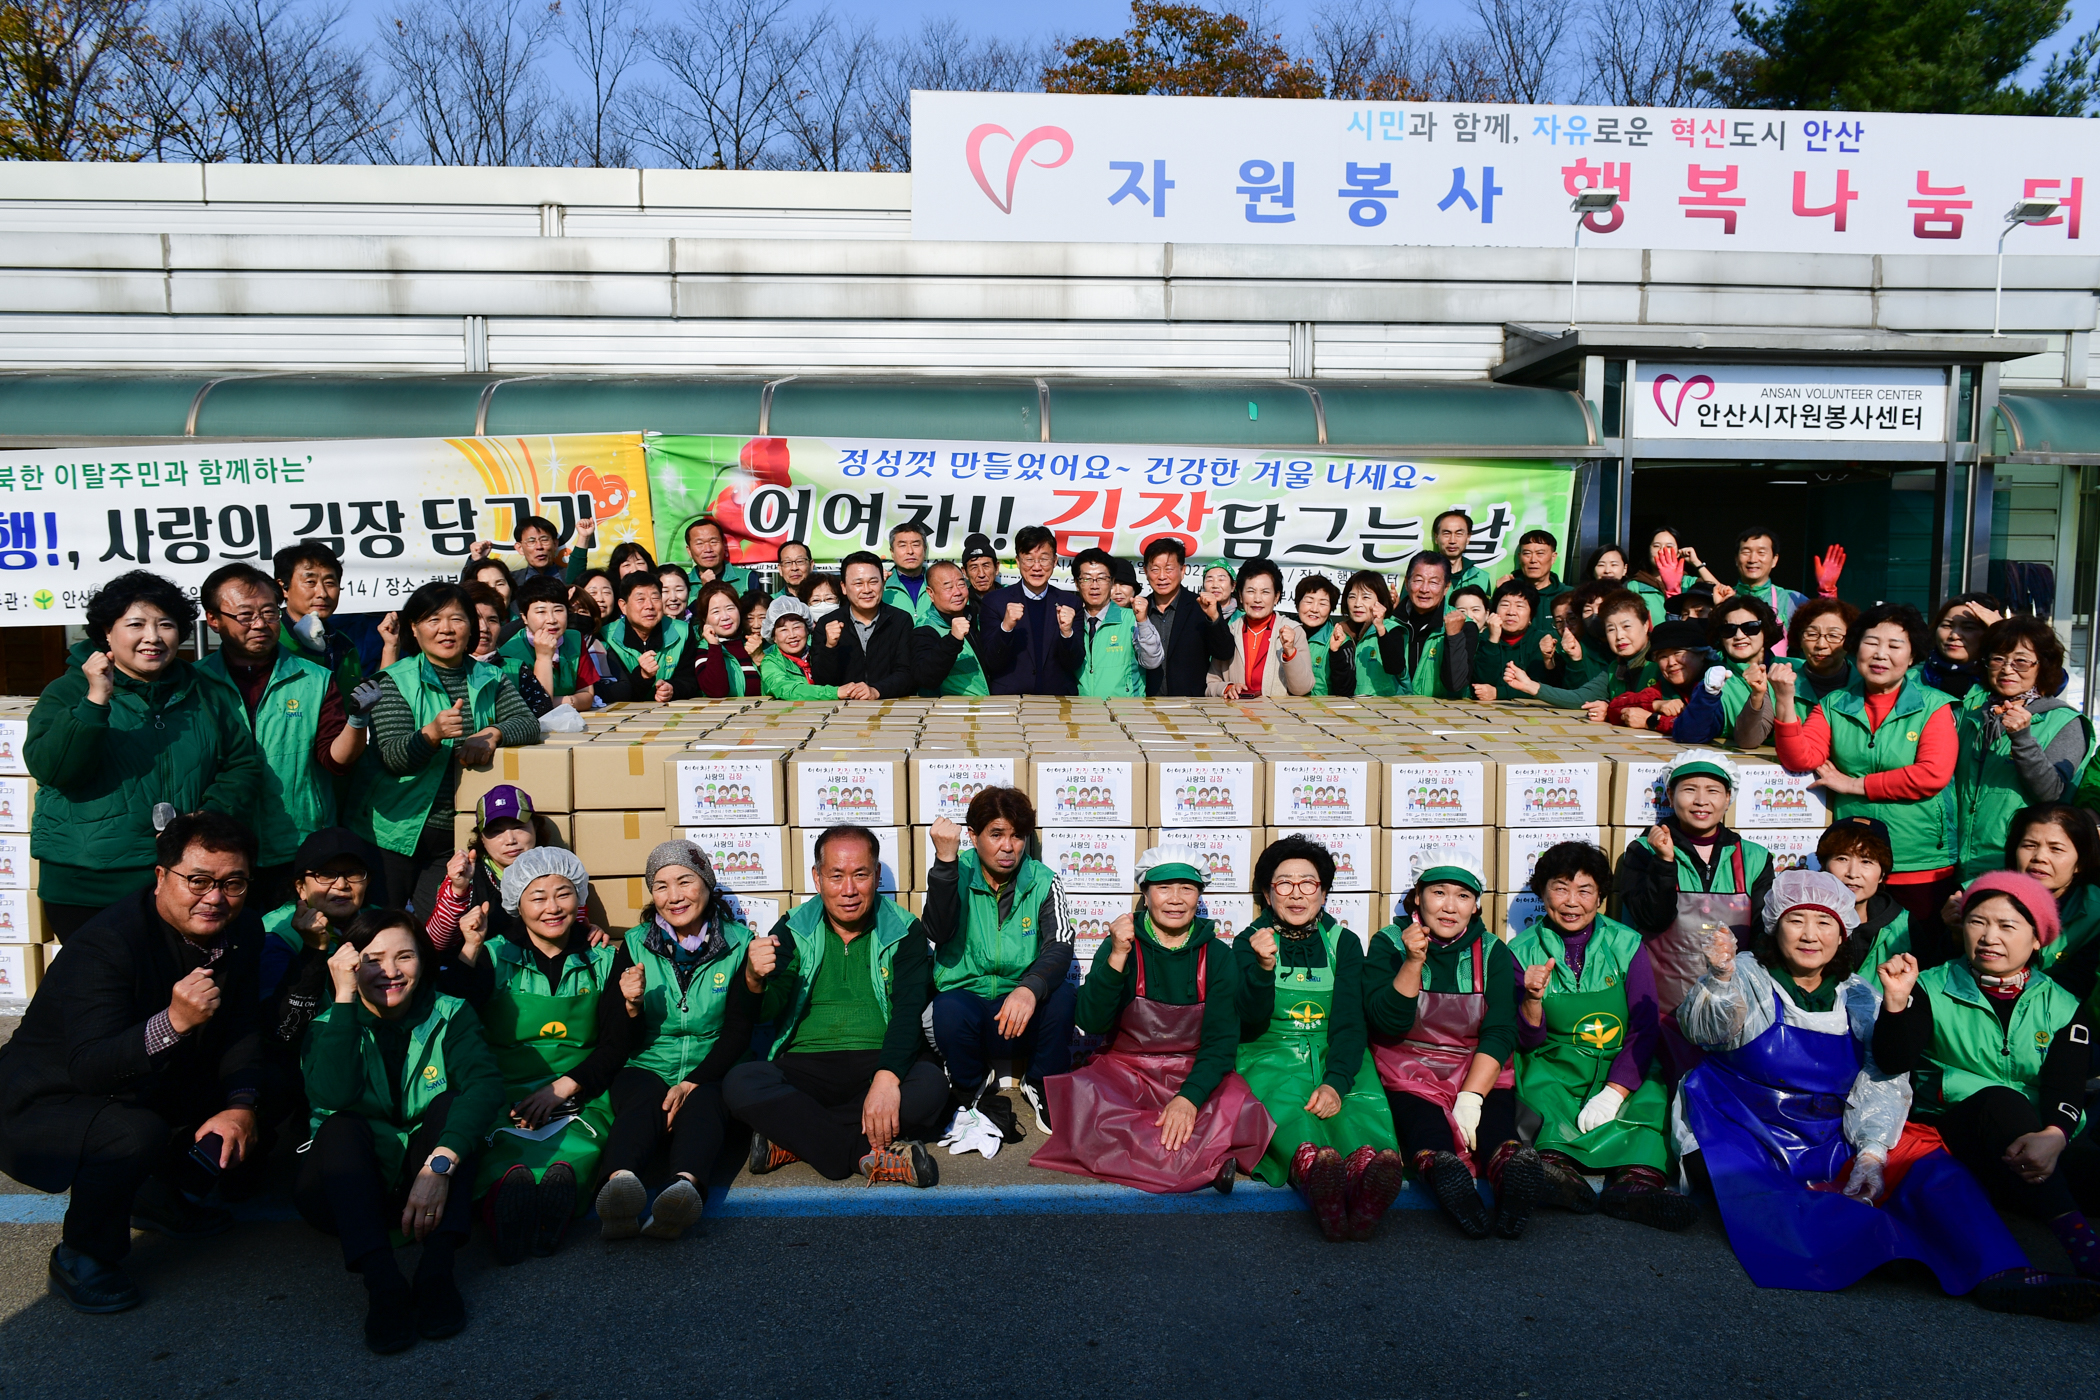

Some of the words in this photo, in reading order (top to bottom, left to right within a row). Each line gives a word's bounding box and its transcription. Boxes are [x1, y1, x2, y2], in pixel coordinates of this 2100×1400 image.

[1346, 110, 1438, 143] 시민과
[1452, 112, 1519, 145] 함께,
[1531, 113, 1654, 148] 자유로운
[1669, 117, 1786, 151] 혁신도시
[1802, 120, 1865, 153] 안산
[1760, 388, 1801, 399] ANSAN
[1805, 388, 1873, 400] VOLUNTEER
[1877, 389, 1923, 401] CENTER
[1697, 403, 1922, 431] 안산시자원봉사센터
[0, 464, 44, 492] 북한
[55, 461, 188, 492] 이탈주민과
[837, 448, 935, 479] 정성껏
[951, 451, 1131, 482] 만들었어요~
[1143, 456, 1241, 486] 건강한
[1251, 457, 1314, 489] 겨울
[1326, 462, 1437, 491] 나세요~
[99, 504, 273, 564] 사랑의
[289, 499, 405, 559] 김장
[749, 488, 1015, 550] 어여차!!
[285, 711, 303, 719] SMU
[425, 1078, 447, 1092] SMU
